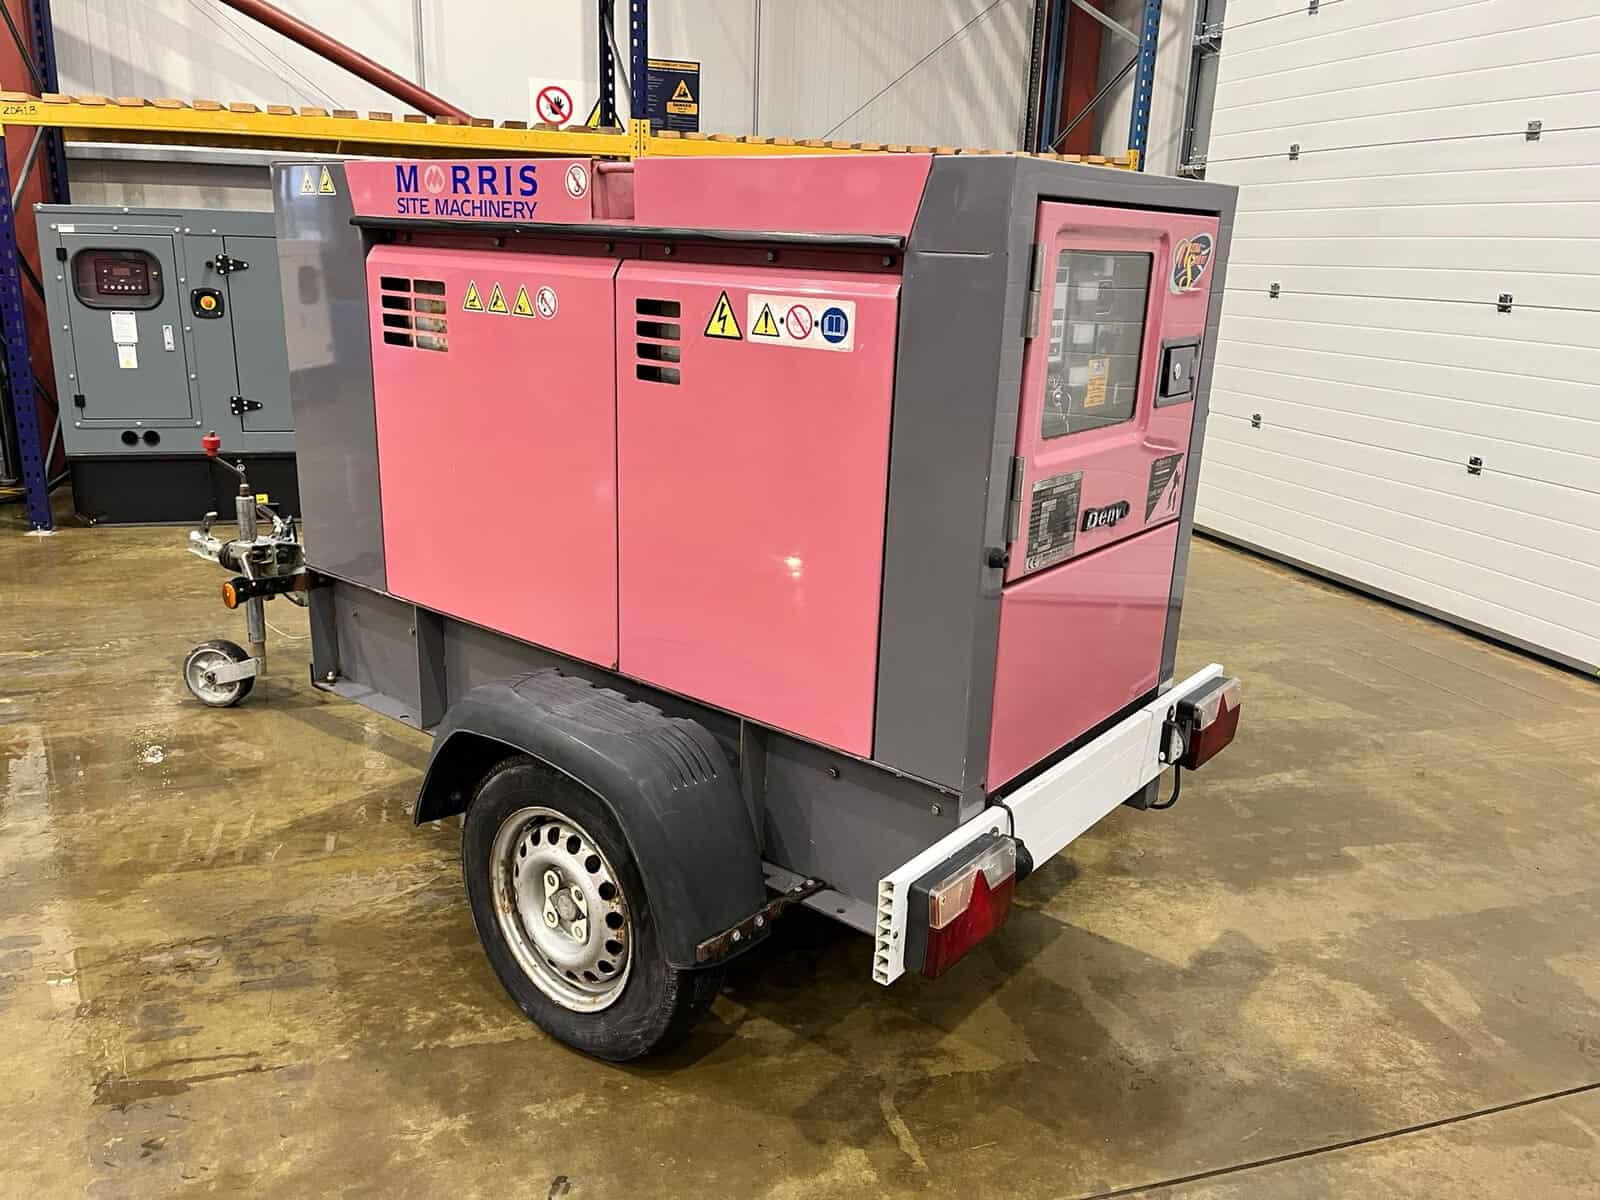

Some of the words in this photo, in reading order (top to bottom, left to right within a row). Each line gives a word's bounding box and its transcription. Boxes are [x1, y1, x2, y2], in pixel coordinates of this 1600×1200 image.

[395, 164, 538, 196] MORRIS
[397, 197, 430, 214] SITE
[435, 198, 537, 219] MACHINERY
